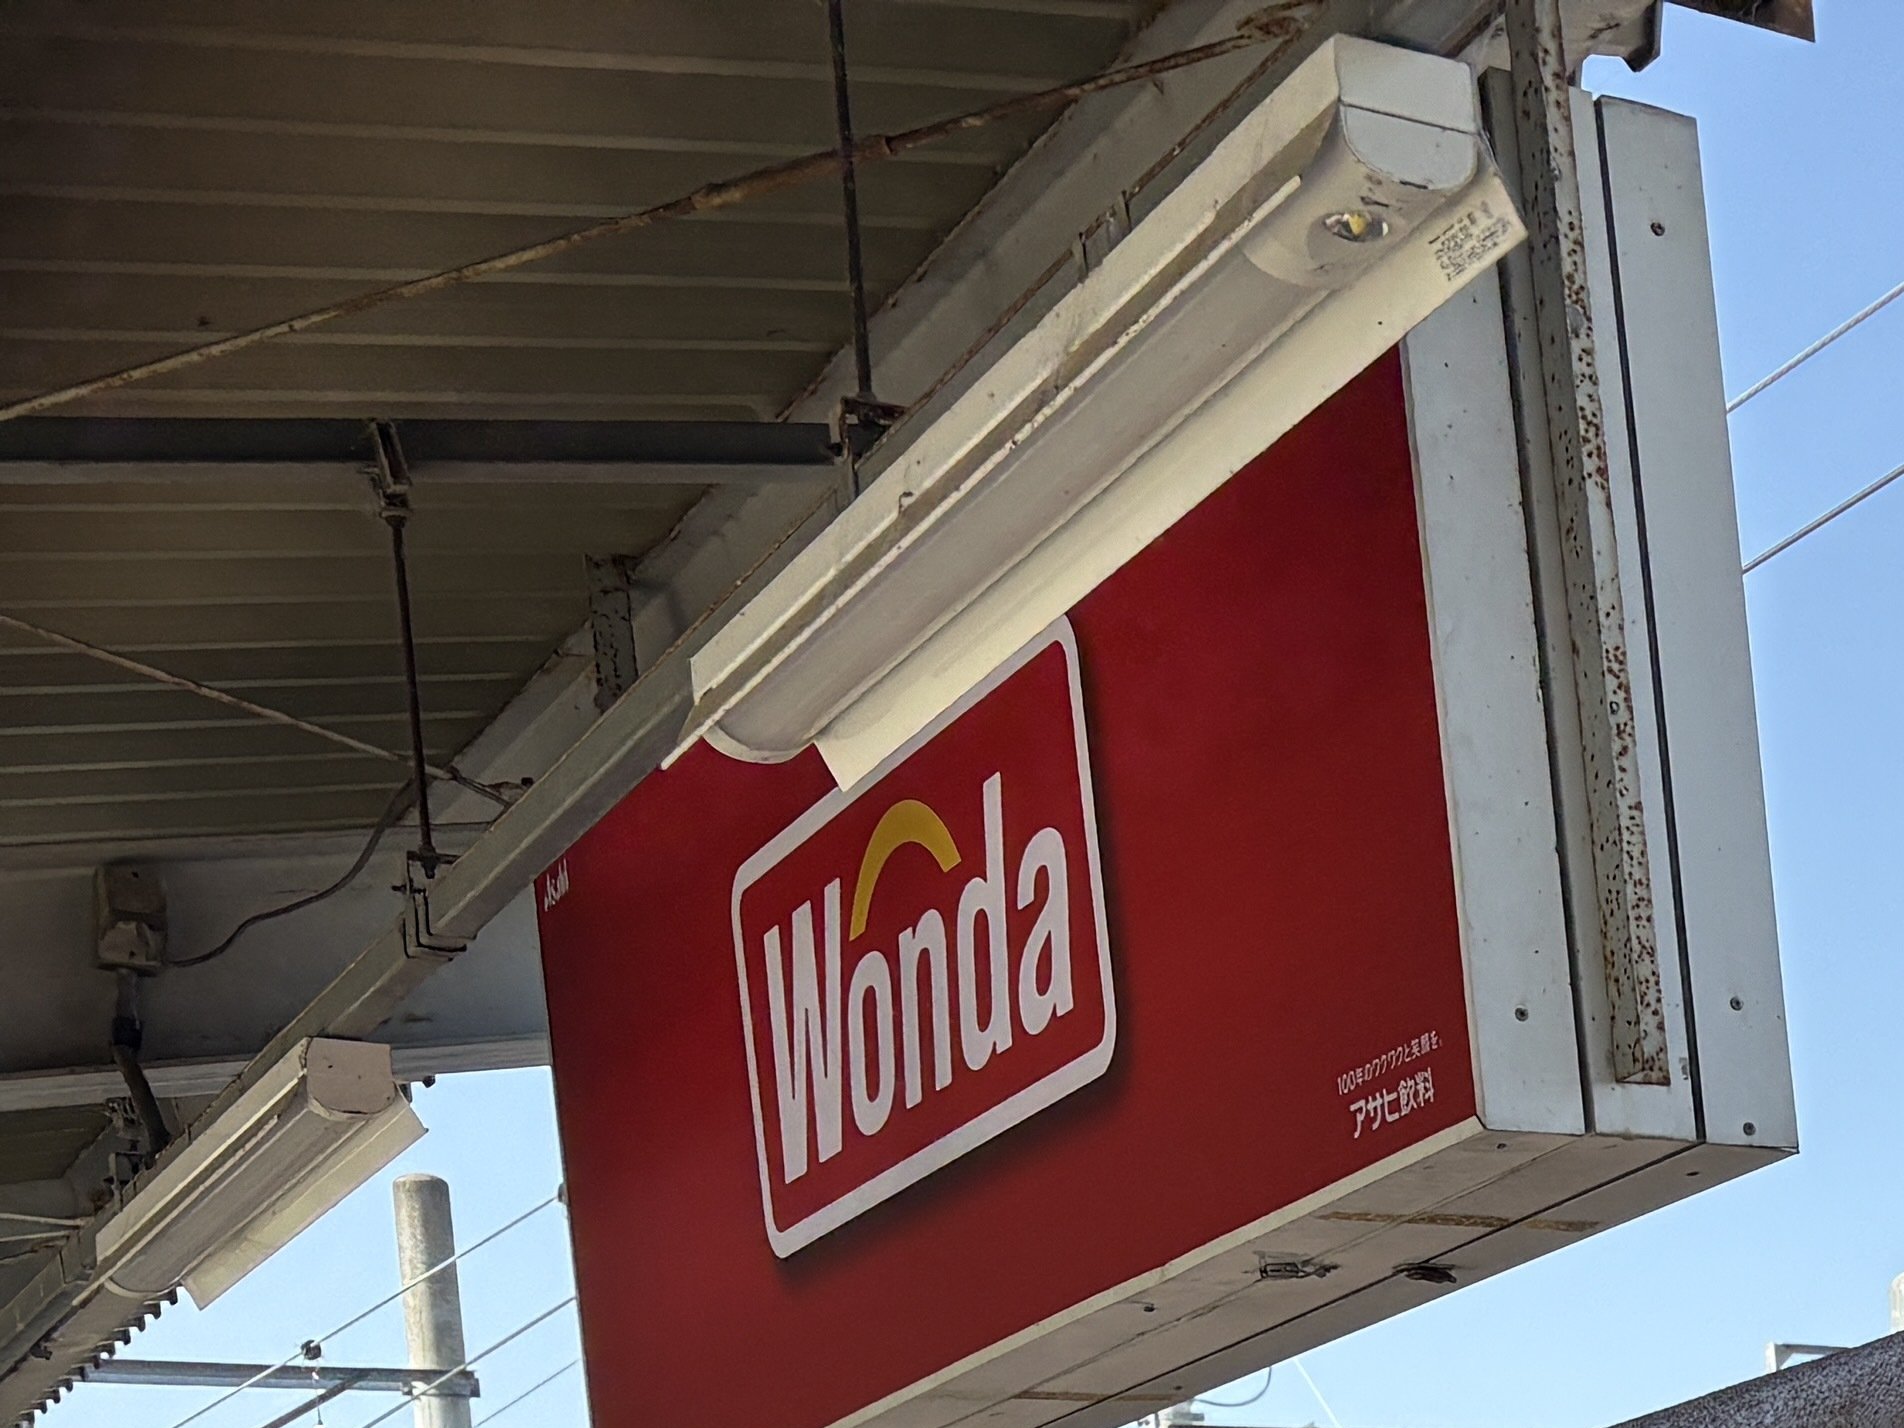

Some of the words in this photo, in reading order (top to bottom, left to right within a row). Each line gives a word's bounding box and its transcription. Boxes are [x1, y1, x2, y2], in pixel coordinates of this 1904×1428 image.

[764, 772, 1073, 1183] Wonda
[1350, 1067, 1434, 1138] アサヒ飲料
